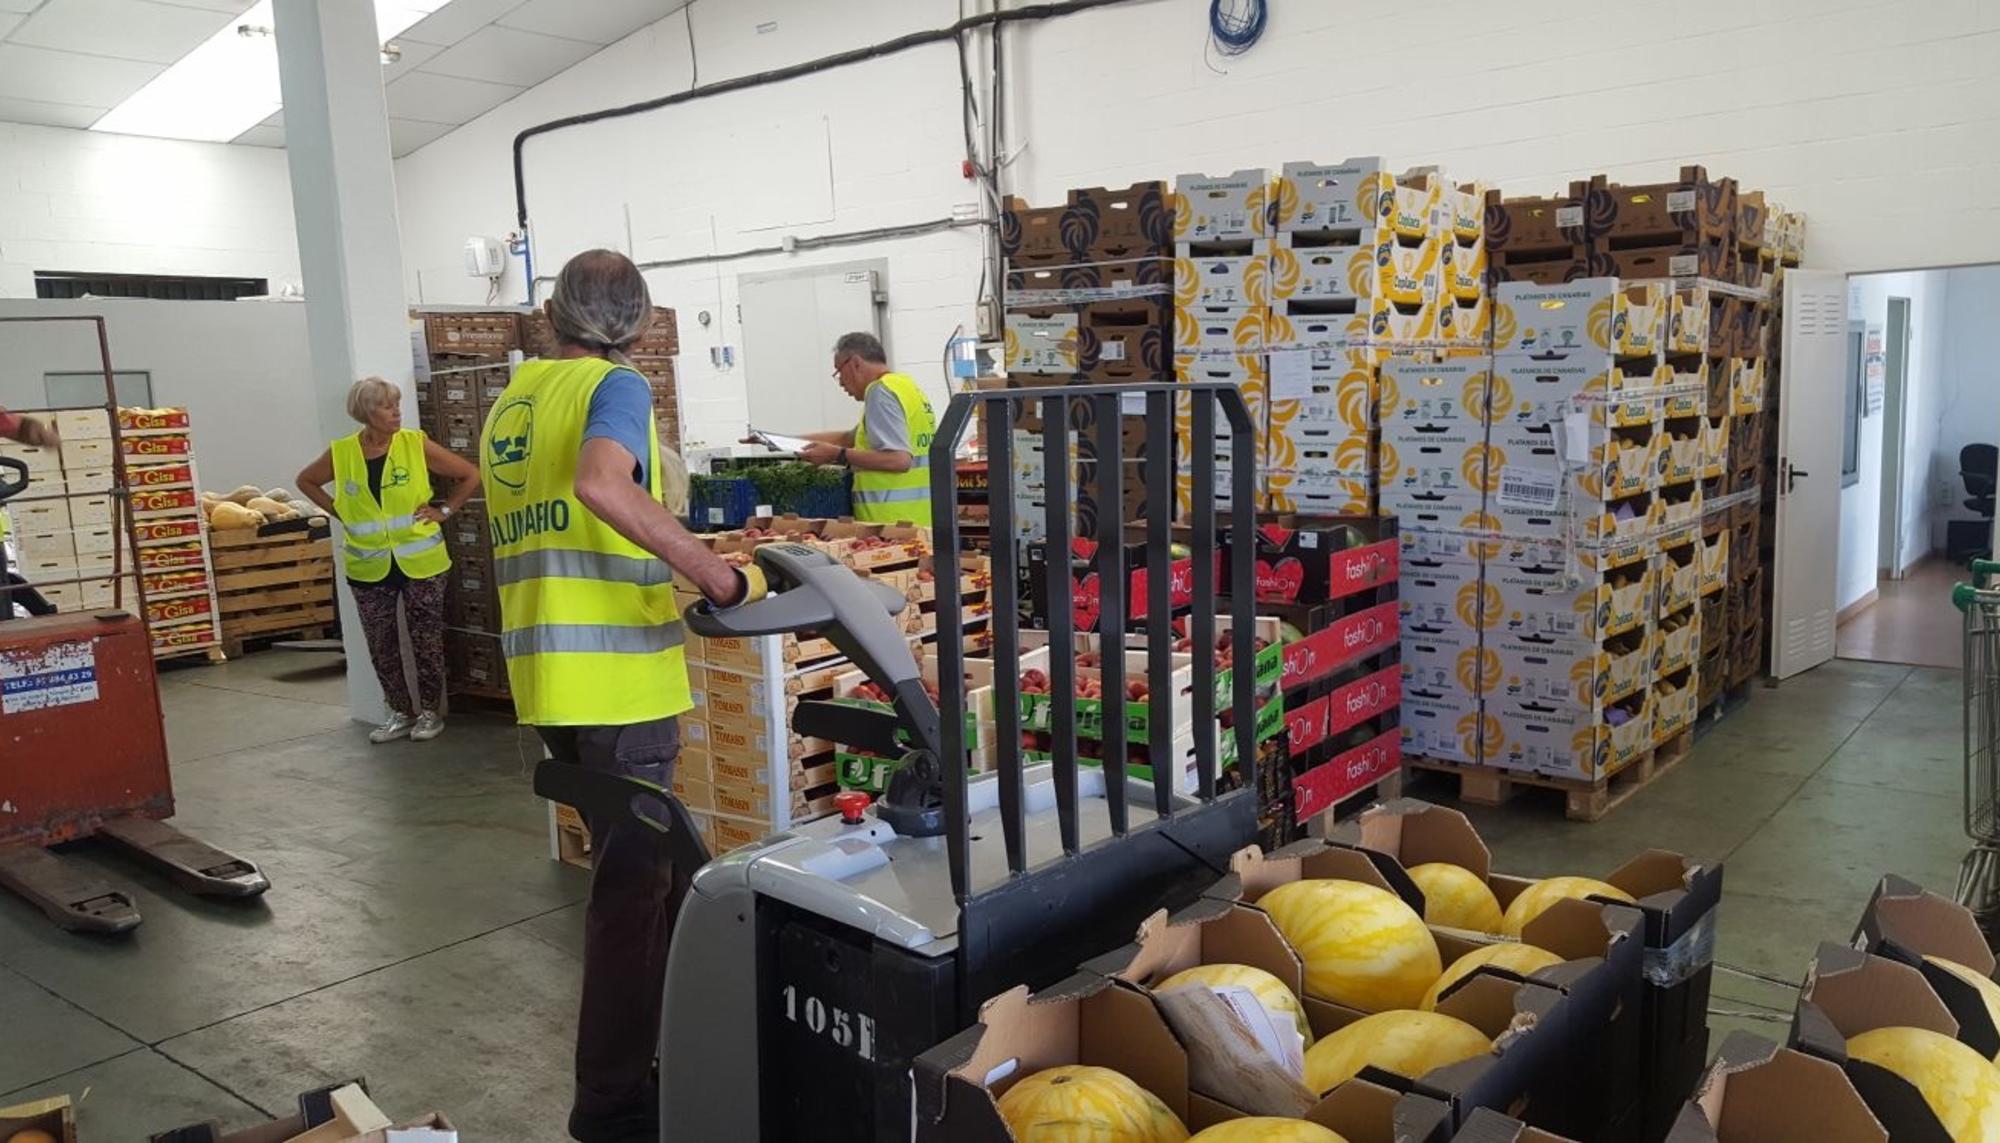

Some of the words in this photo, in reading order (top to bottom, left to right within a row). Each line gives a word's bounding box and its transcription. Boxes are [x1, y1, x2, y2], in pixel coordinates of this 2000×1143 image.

[1398, 212, 1420, 228] Coplaca
[136, 414, 166, 429] Gisa
[138, 441, 168, 454] Gisa
[144, 470, 175, 484] Gisa
[148, 496, 180, 510] Gisa
[152, 526, 182, 538] Gisa
[164, 604, 195, 619] Gisa
[168, 631, 197, 646] Gisa
